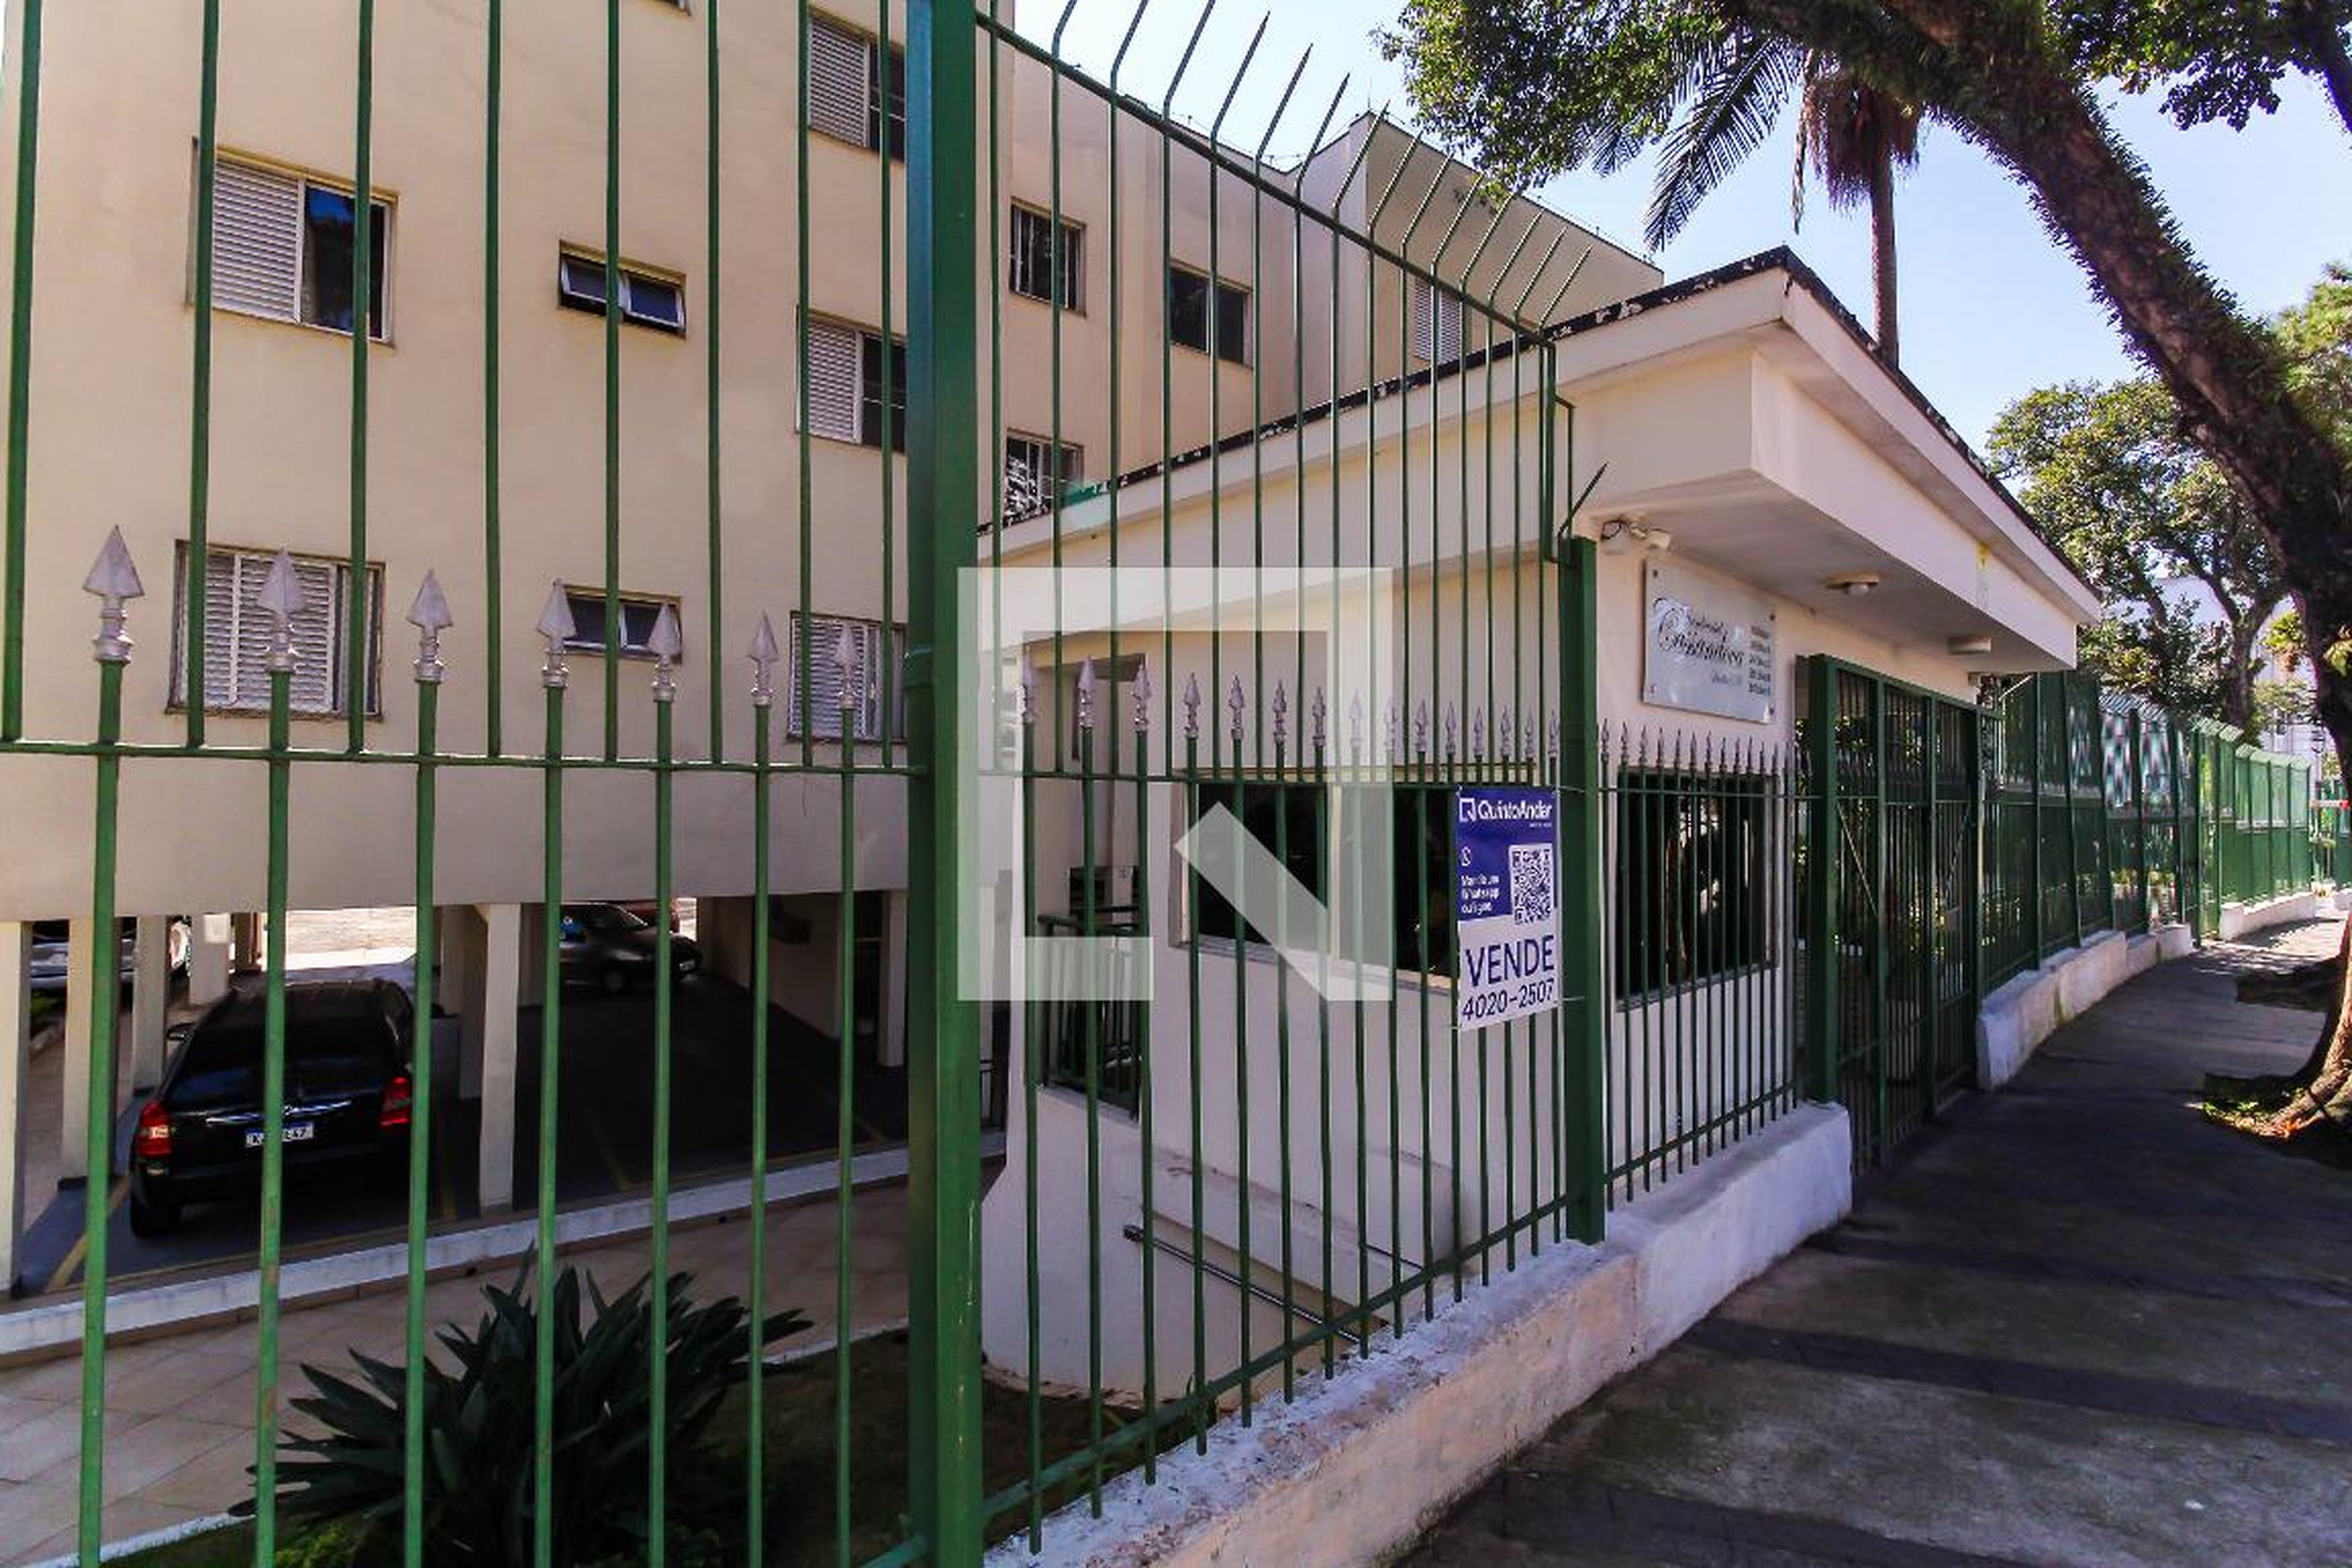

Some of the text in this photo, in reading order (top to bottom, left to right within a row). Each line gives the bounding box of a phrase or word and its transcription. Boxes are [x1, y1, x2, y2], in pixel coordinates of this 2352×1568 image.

[1477, 799, 1553, 820] QuintoAndar
[1465, 935, 1555, 987] VENDE
[1461, 979, 1555, 1021] 4020-2507
